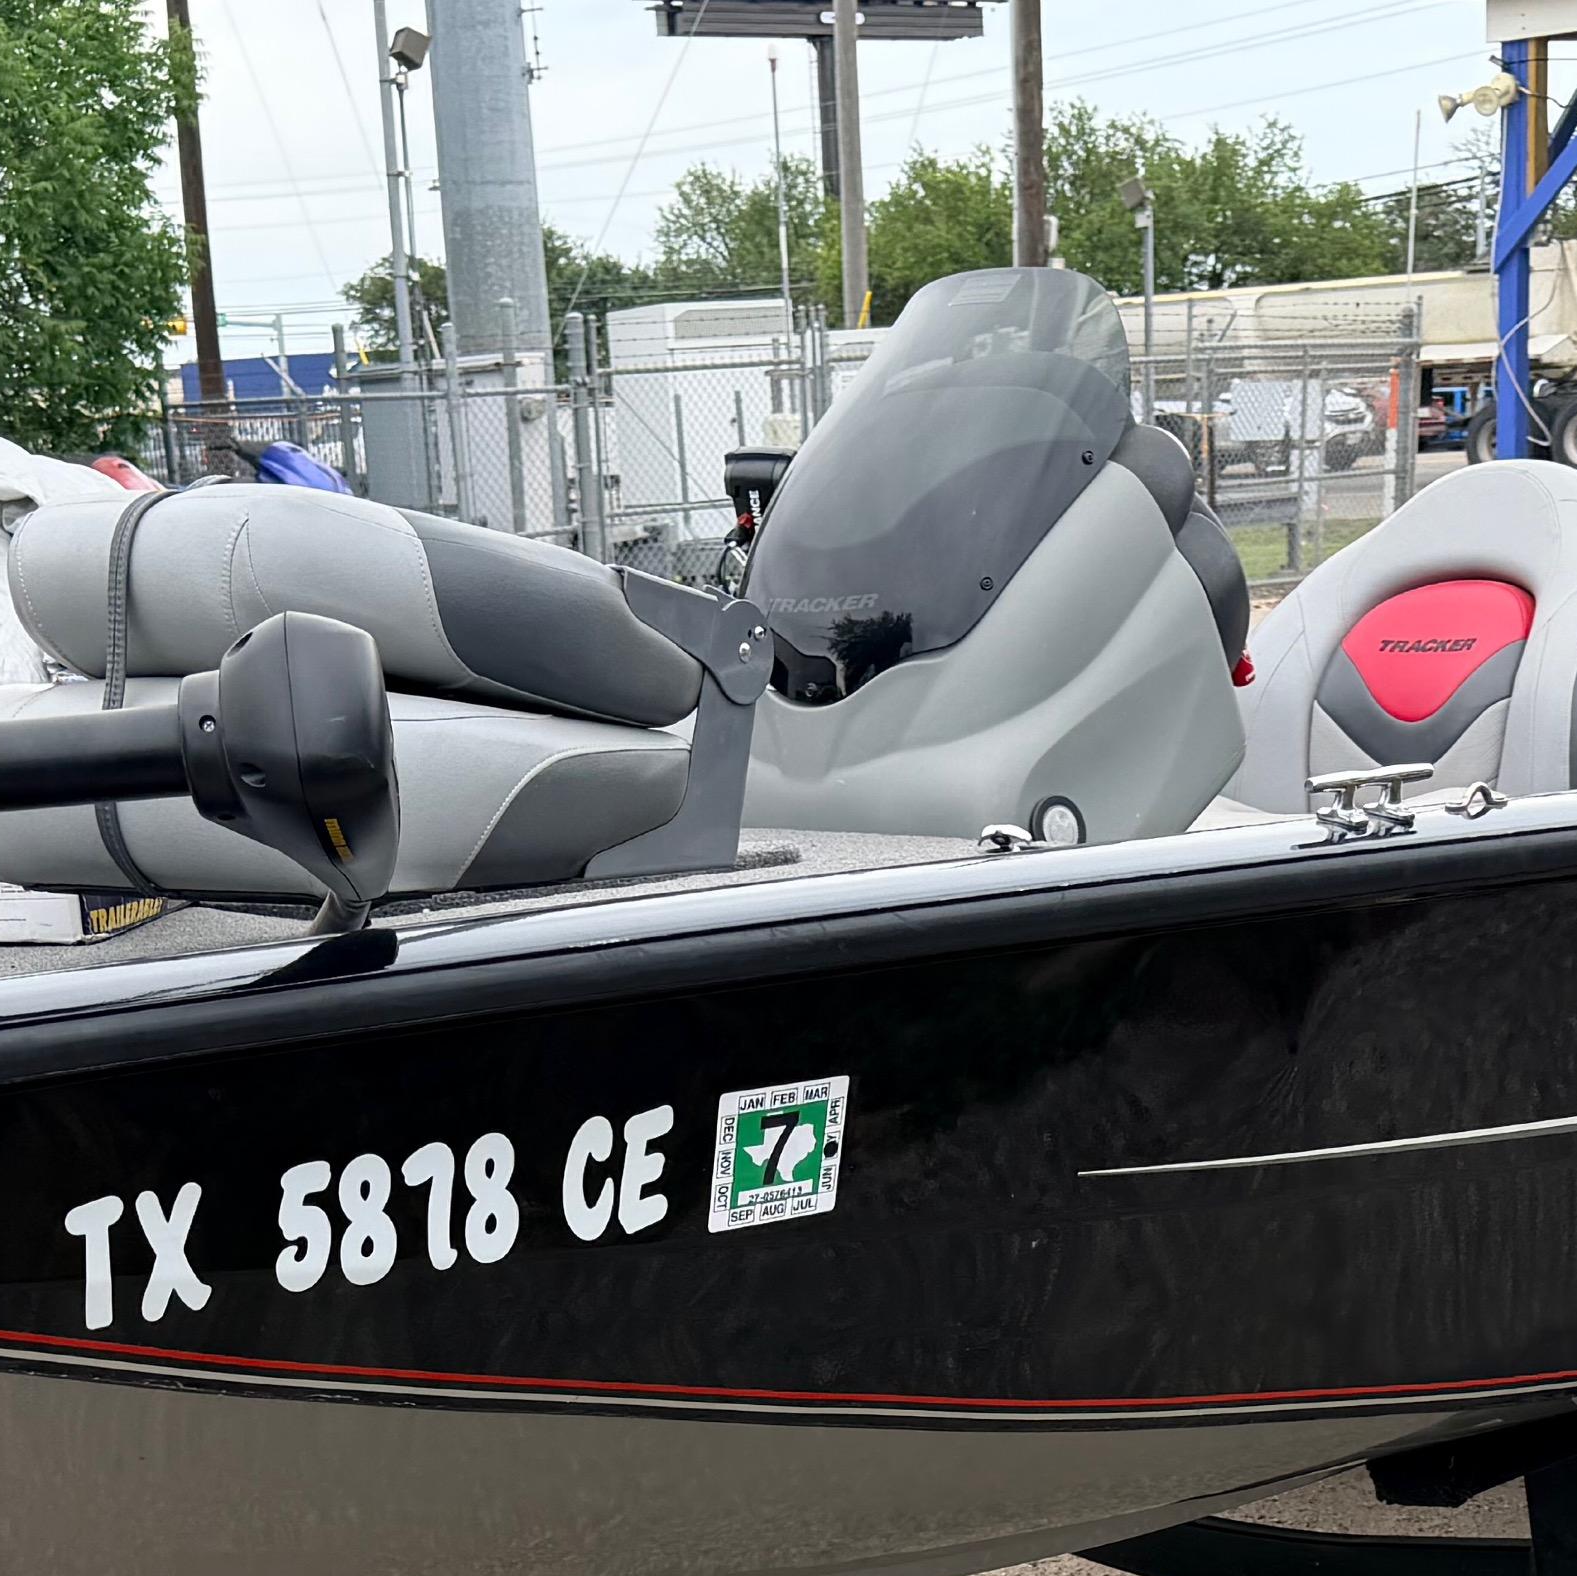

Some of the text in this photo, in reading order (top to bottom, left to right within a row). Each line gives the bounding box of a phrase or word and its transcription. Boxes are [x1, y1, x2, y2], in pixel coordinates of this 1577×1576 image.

[749, 490, 763, 531] ANCE
[1378, 638, 1477, 653] TRACKER
[740, 1086, 829, 1110] JAN FEB MAR
[829, 1099, 841, 1124] APR
[723, 1117, 735, 1142] DEC
[760, 1111, 800, 1185] 7
[720, 1151, 732, 1175] NOV
[822, 1167, 832, 1189] JUN
[717, 1185, 729, 1209] OCT
[64, 1182, 212, 1331] TX
[564, 1104, 675, 1241] CE
[731, 1198, 815, 1222] SEP AUG JUL
